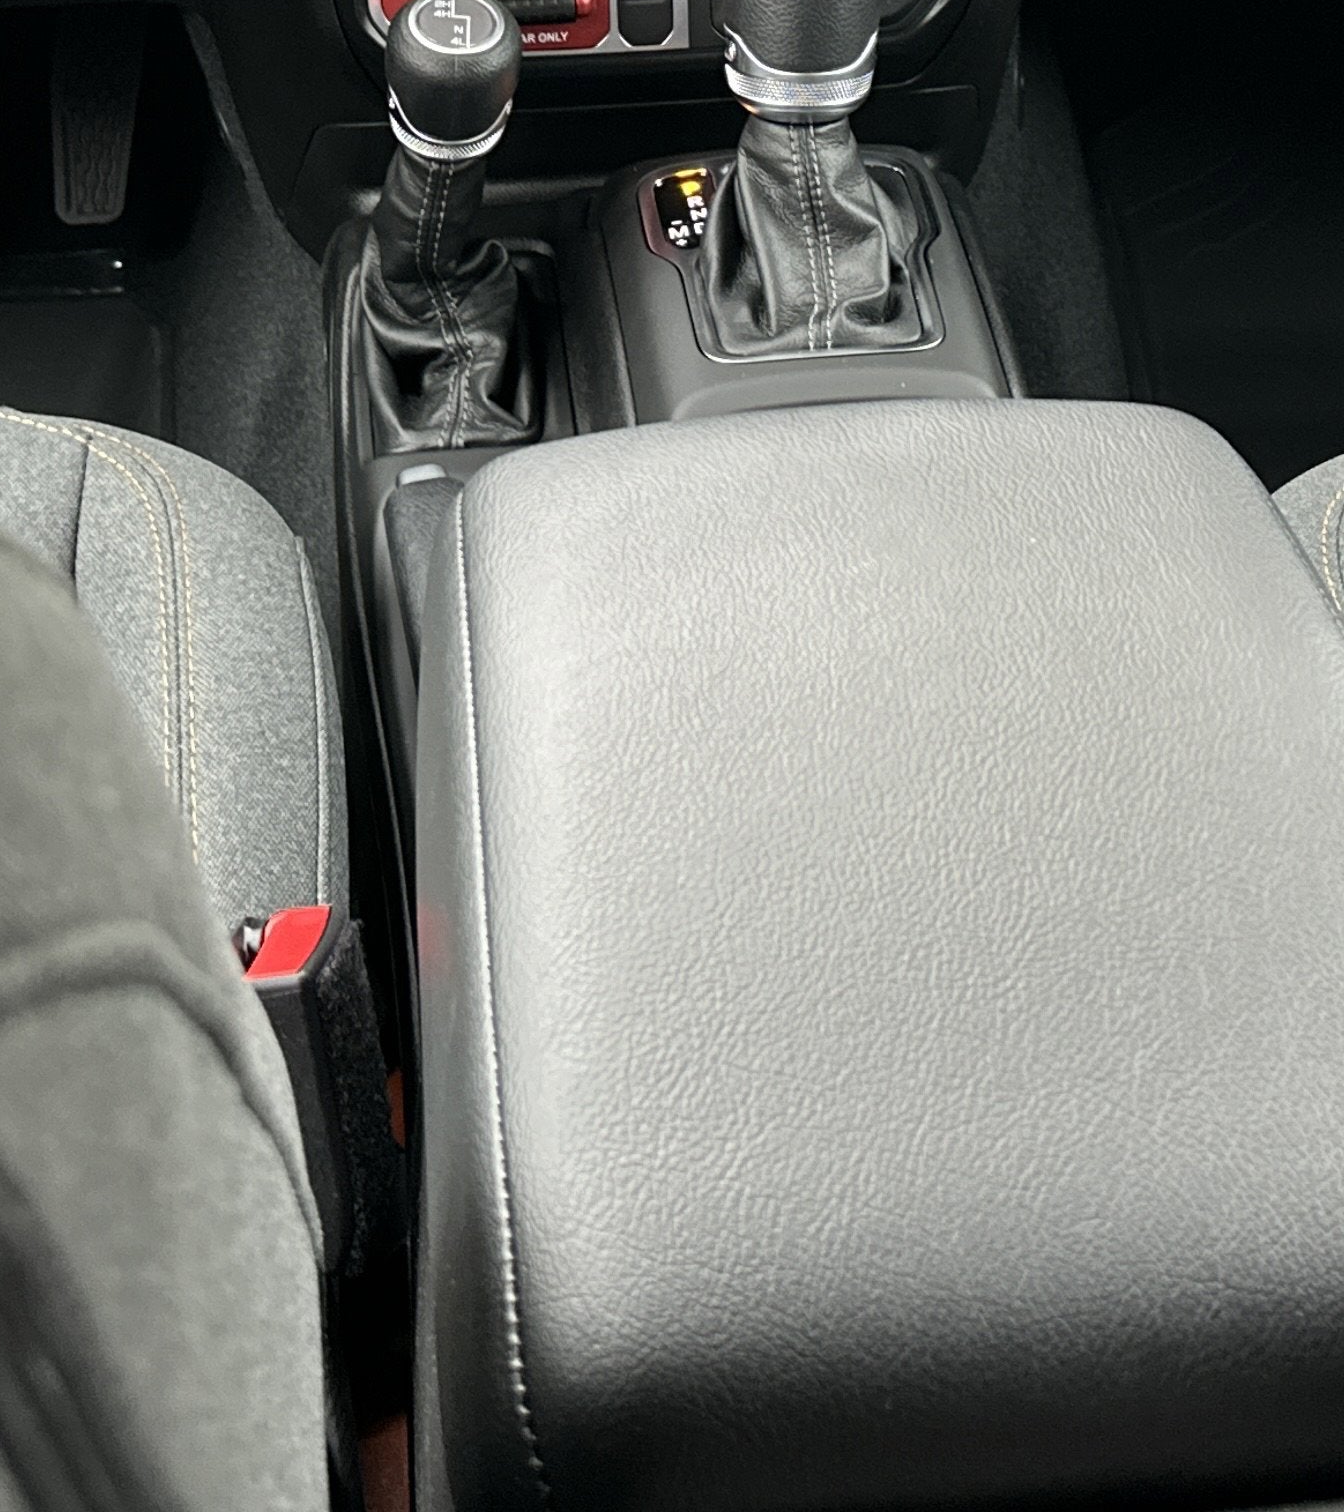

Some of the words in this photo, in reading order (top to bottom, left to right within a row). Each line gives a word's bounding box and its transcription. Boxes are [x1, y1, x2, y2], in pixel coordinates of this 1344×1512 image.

[433, 10, 451, 18] 4H
[453, 25, 464, 34] N
[450, 37, 466, 46] 4L
[537, 31, 569, 44] ONLY
[680, 181, 701, 196] P
[687, 195, 705, 209] R
[690, 208, 708, 221] N
[668, 225, 690, 240] M
